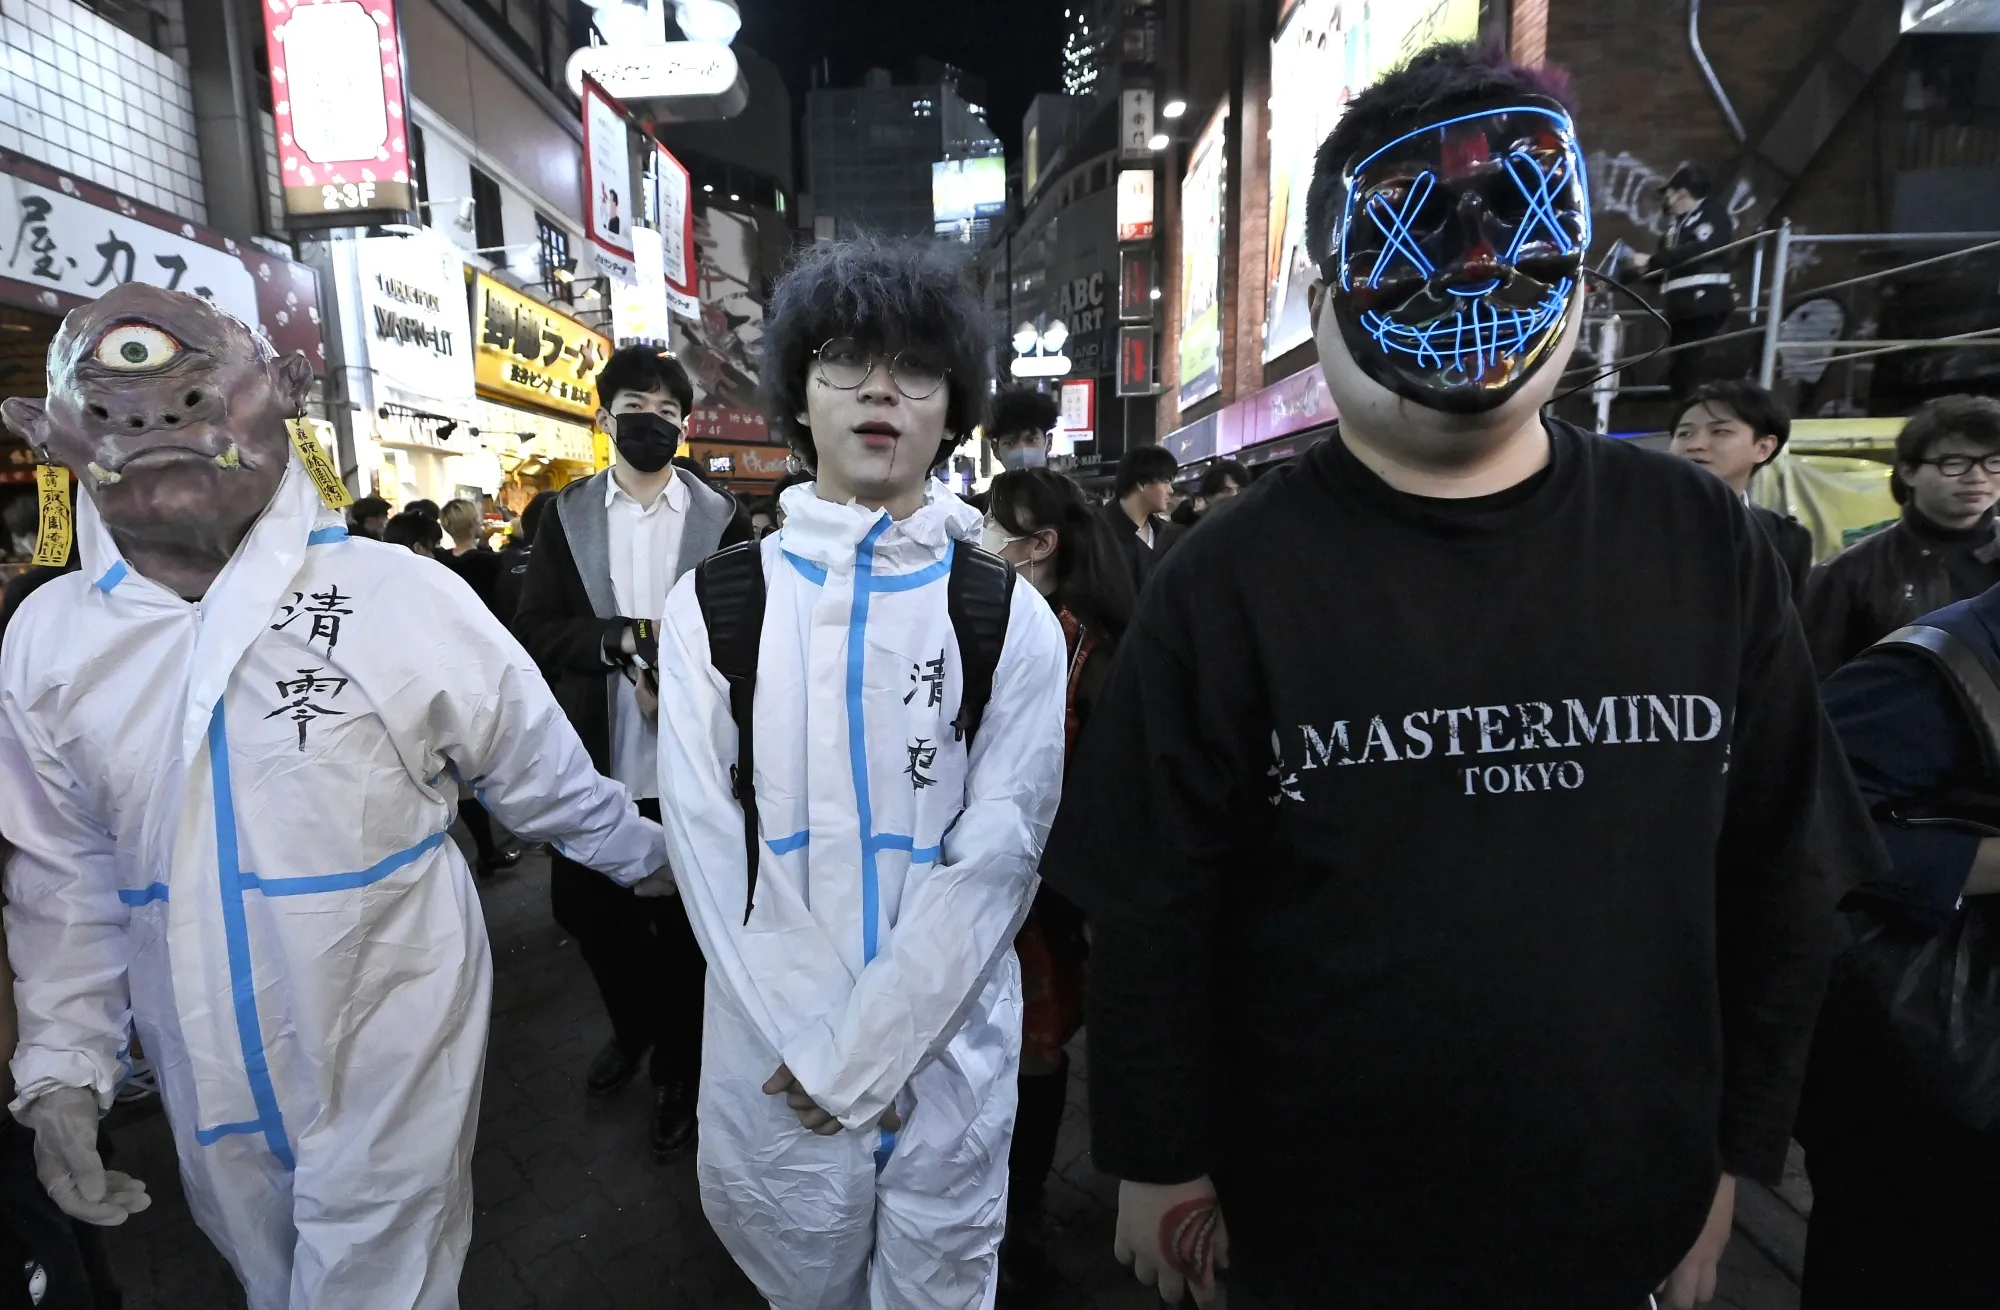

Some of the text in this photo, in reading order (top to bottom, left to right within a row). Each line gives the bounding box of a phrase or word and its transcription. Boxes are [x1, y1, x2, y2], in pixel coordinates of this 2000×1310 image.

[1058, 271, 1104, 317] ABC
[1298, 693, 1723, 771] MASTERMIND
[1463, 760, 1585, 796] TOKYO
